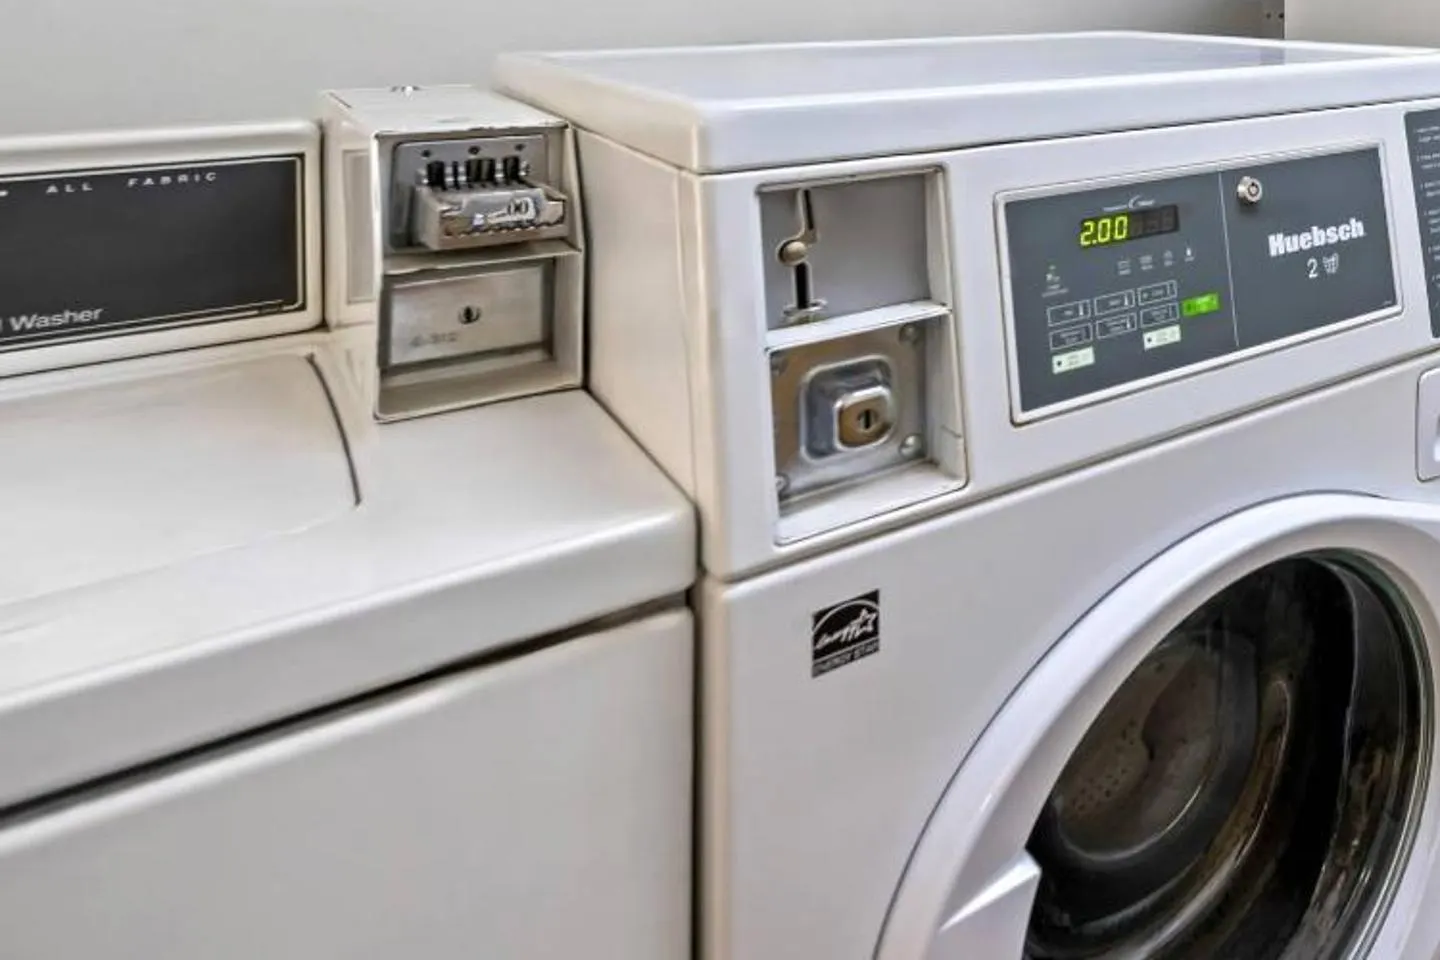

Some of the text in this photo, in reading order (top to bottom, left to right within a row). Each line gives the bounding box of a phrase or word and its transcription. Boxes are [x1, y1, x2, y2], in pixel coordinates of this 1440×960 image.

[46, 171, 217, 194] ALL FABRIC
[1080, 215, 1128, 246] 2.00
[1268, 217, 1366, 257] Huebsch
[1306, 257, 1319, 279] 2
[9, 308, 104, 331] Washer
